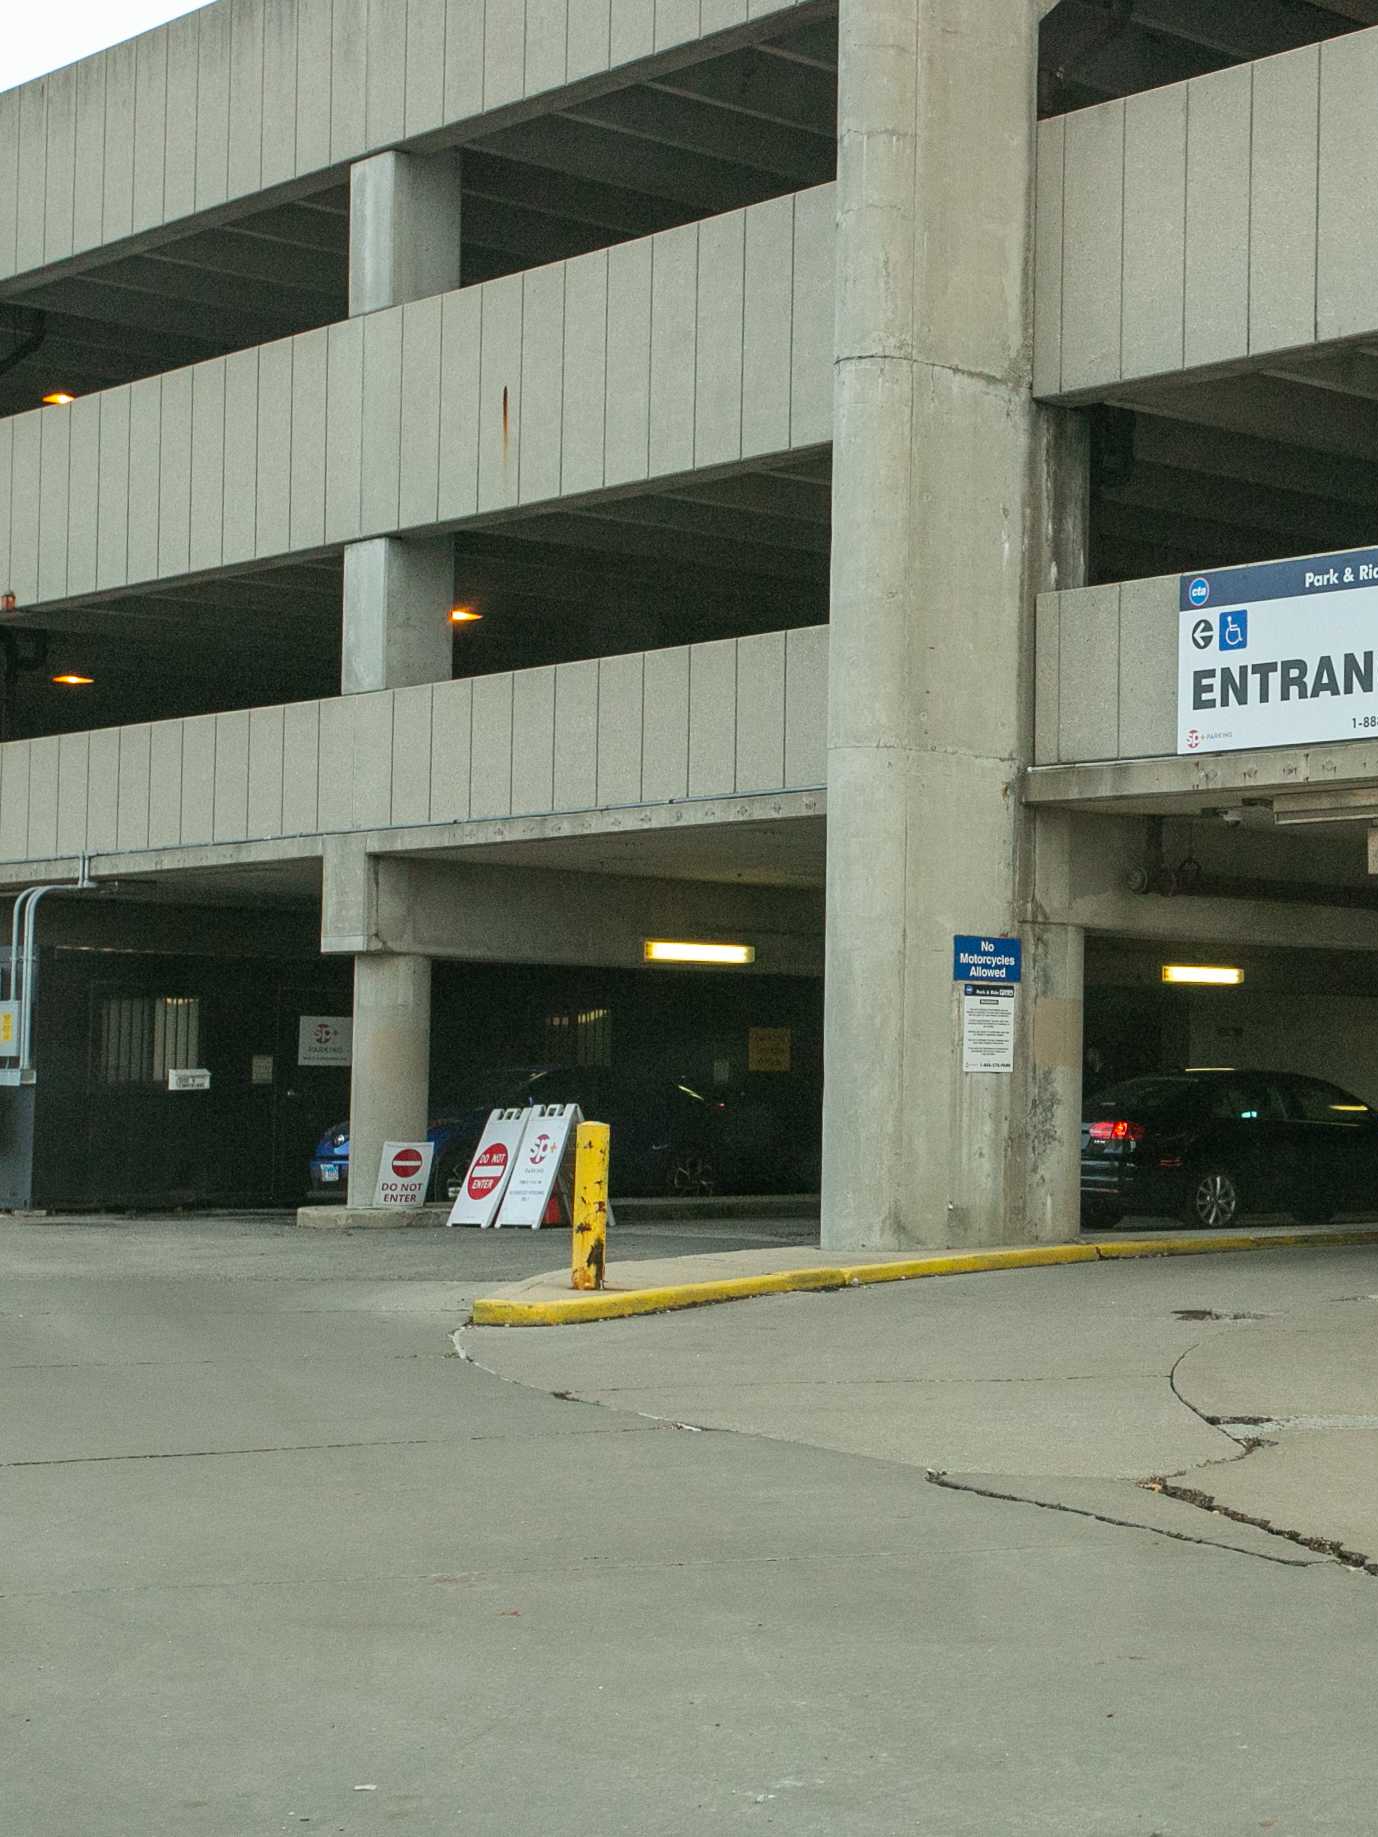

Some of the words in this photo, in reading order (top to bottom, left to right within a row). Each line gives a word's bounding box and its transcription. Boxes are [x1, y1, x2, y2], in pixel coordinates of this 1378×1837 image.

[1305, 568, 1338, 587] Park
[1343, 568, 1354, 583] &
[981, 941, 995, 952] No
[960, 953, 1015, 965] Motorcycles
[970, 967, 1006, 977] Allowed
[479, 1154, 490, 1163] DO
[382, 1183, 397, 1192] DO
[401, 1183, 422, 1191] NOT
[472, 1179, 493, 1190] ENTER
[384, 1194, 417, 1203] ENTER
